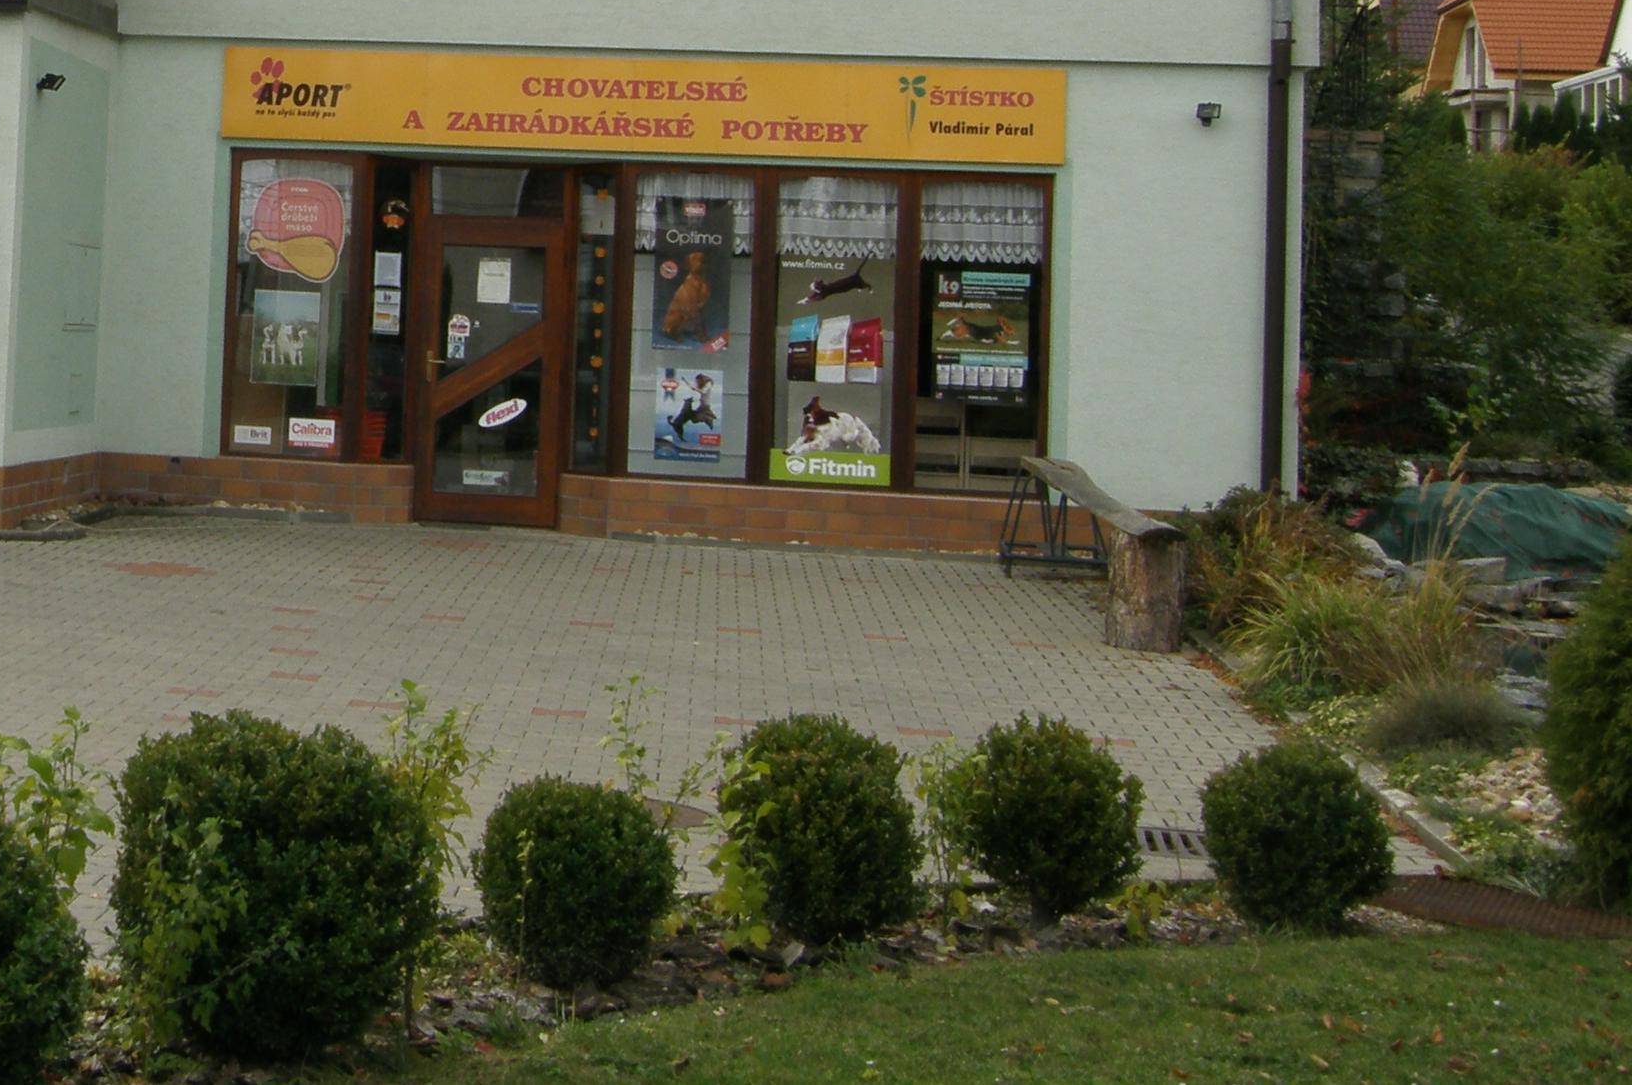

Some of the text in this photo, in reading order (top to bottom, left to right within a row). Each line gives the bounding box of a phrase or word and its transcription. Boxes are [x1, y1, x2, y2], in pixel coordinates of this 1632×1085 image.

[521, 76, 748, 102] CHOVATELSKÉ
[929, 86, 1035, 108] ŠTÍSTKO
[402, 109, 869, 143] A ZAHRÁDKÁŘSKÉ POTŘEBY
[929, 121, 1034, 136] Vladimír Páral
[666, 229, 722, 246] Optima
[781, 258, 845, 270] www.fitmin.cz
[291, 422, 333, 436] Calibra
[808, 458, 876, 478] Fitmin
